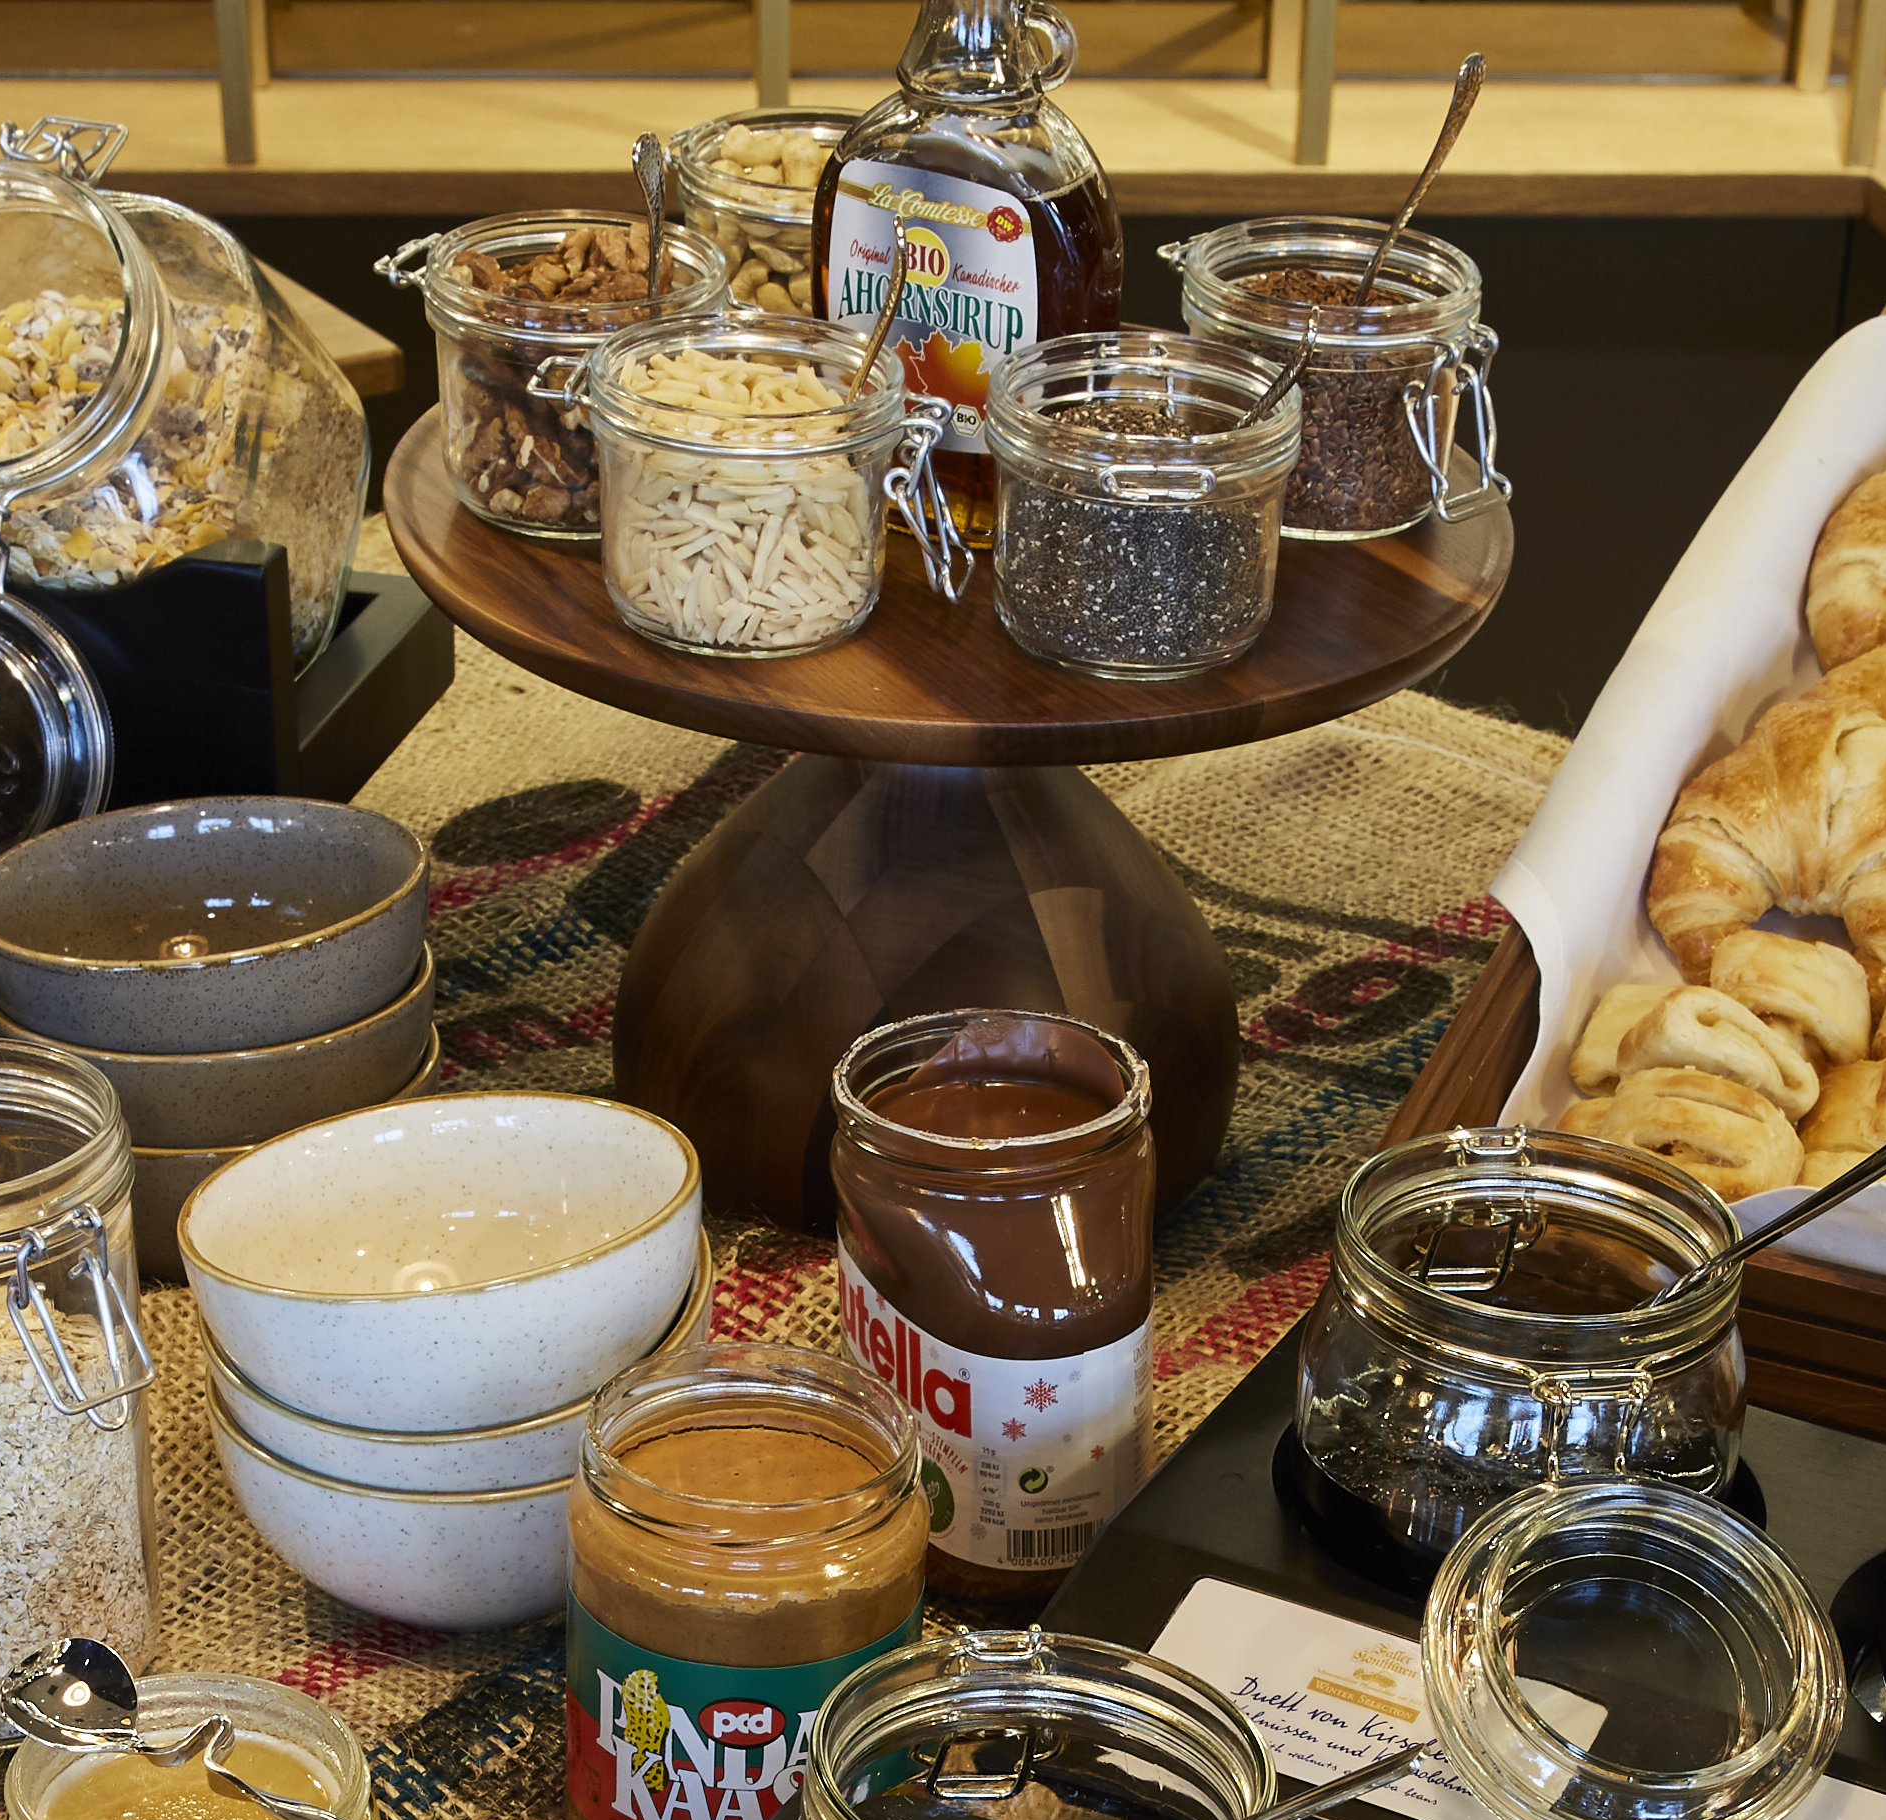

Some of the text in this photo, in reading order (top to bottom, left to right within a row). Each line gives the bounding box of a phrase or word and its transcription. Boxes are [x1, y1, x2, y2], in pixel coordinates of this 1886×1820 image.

[869, 184, 985, 228] La Comtesse
[850, 239, 890, 265] Original
[905, 241, 945, 277] BIO
[952, 263, 1020, 293] Kanadischer
[840, 1266, 972, 1438] utella
[1230, 1676, 1308, 1712] Duett
[1307, 1708, 1349, 1729] von
[713, 1706, 773, 1739] pcd
[1325, 1740, 1370, 1758] und
